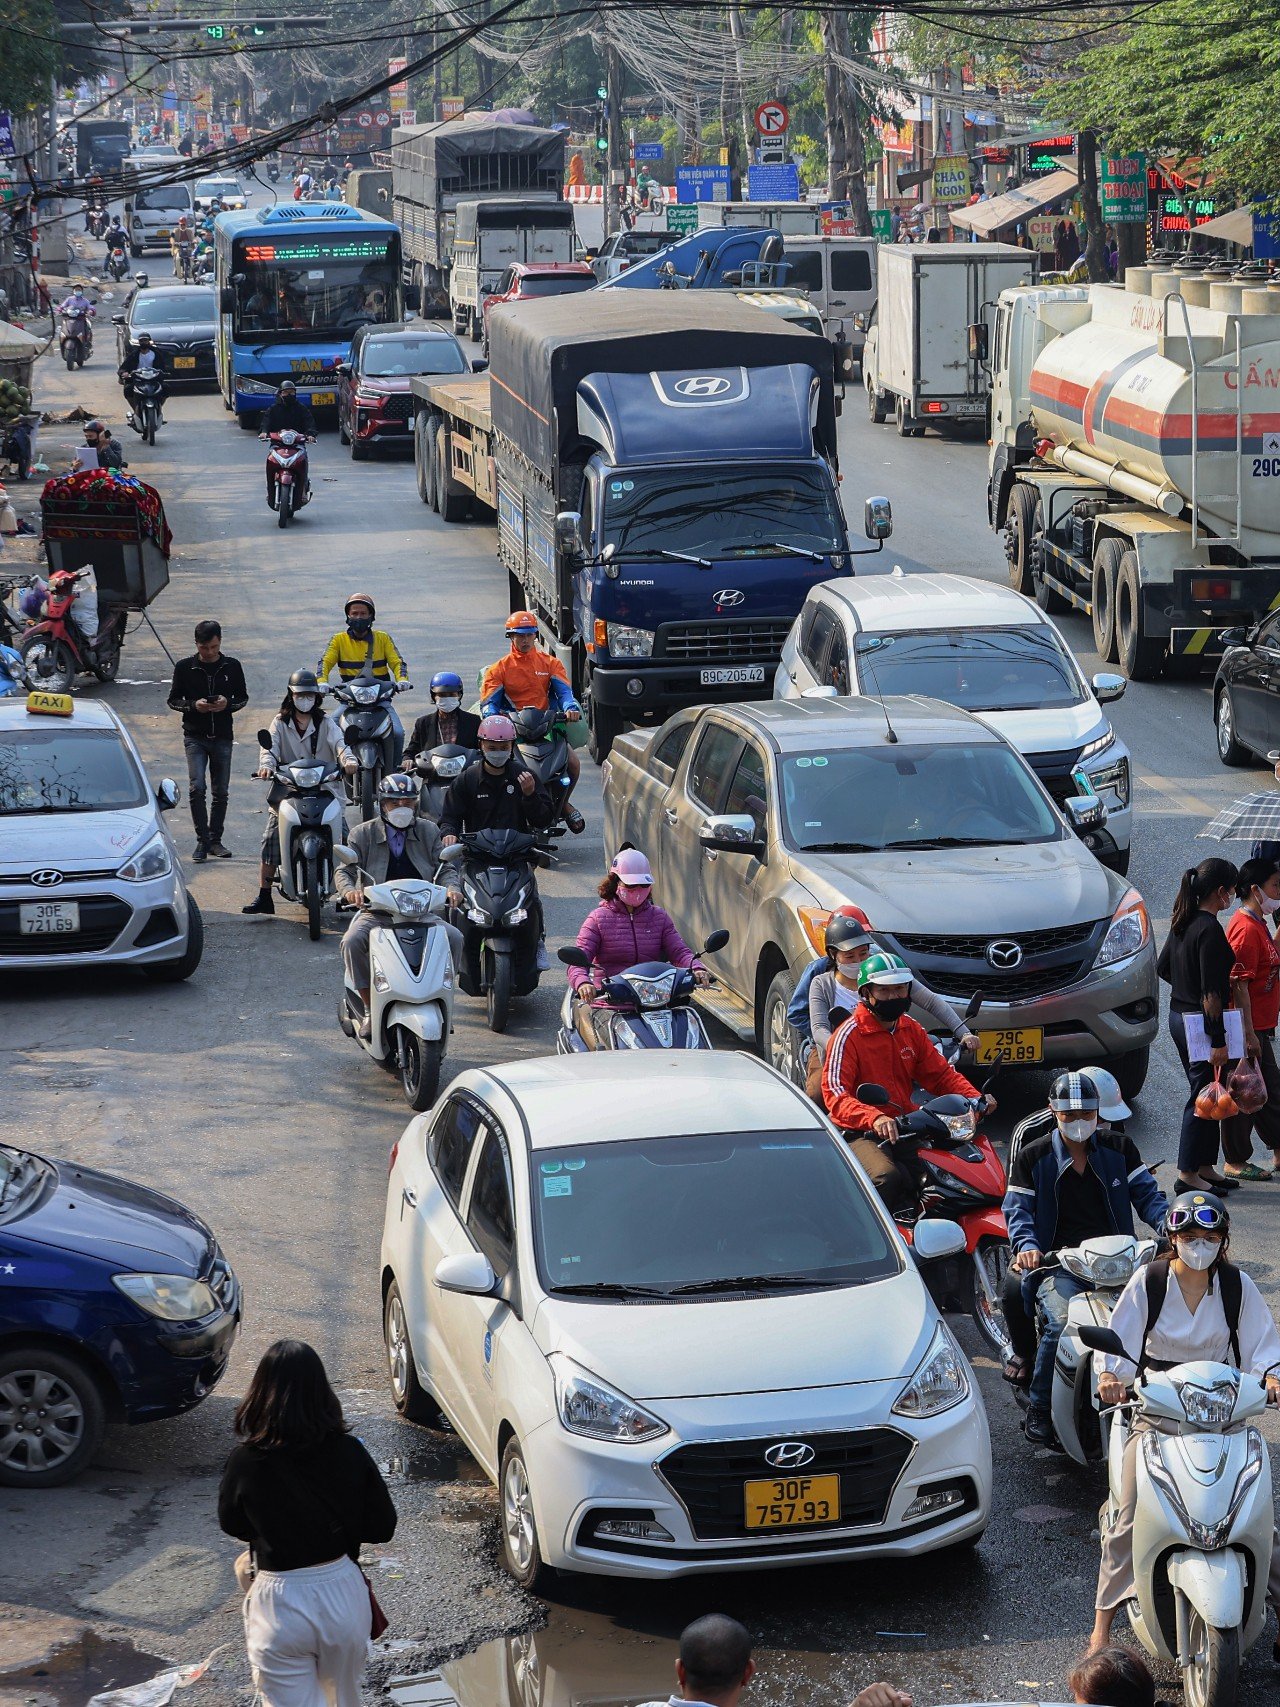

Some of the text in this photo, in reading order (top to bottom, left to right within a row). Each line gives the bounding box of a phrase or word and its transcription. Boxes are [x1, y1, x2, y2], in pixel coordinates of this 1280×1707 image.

[208, 25, 223, 38] 43
[678, 169, 691, 180] BỆNH
[692, 168, 702, 179] VIỆN
[1108, 157, 1139, 180] ĐIỆN
[935, 185, 966, 198] NGON
[1104, 182, 1145, 202] THOẠI
[1252, 458, 1280, 477] 29C
[33, 694, 64, 708] TAXI
[37, 905, 62, 918] 30E
[27, 919, 73, 933] 721.69
[996, 1032, 1024, 1046] 29C
[772, 1480, 811, 1501] 30F
[756, 1500, 829, 1524] 757.93
